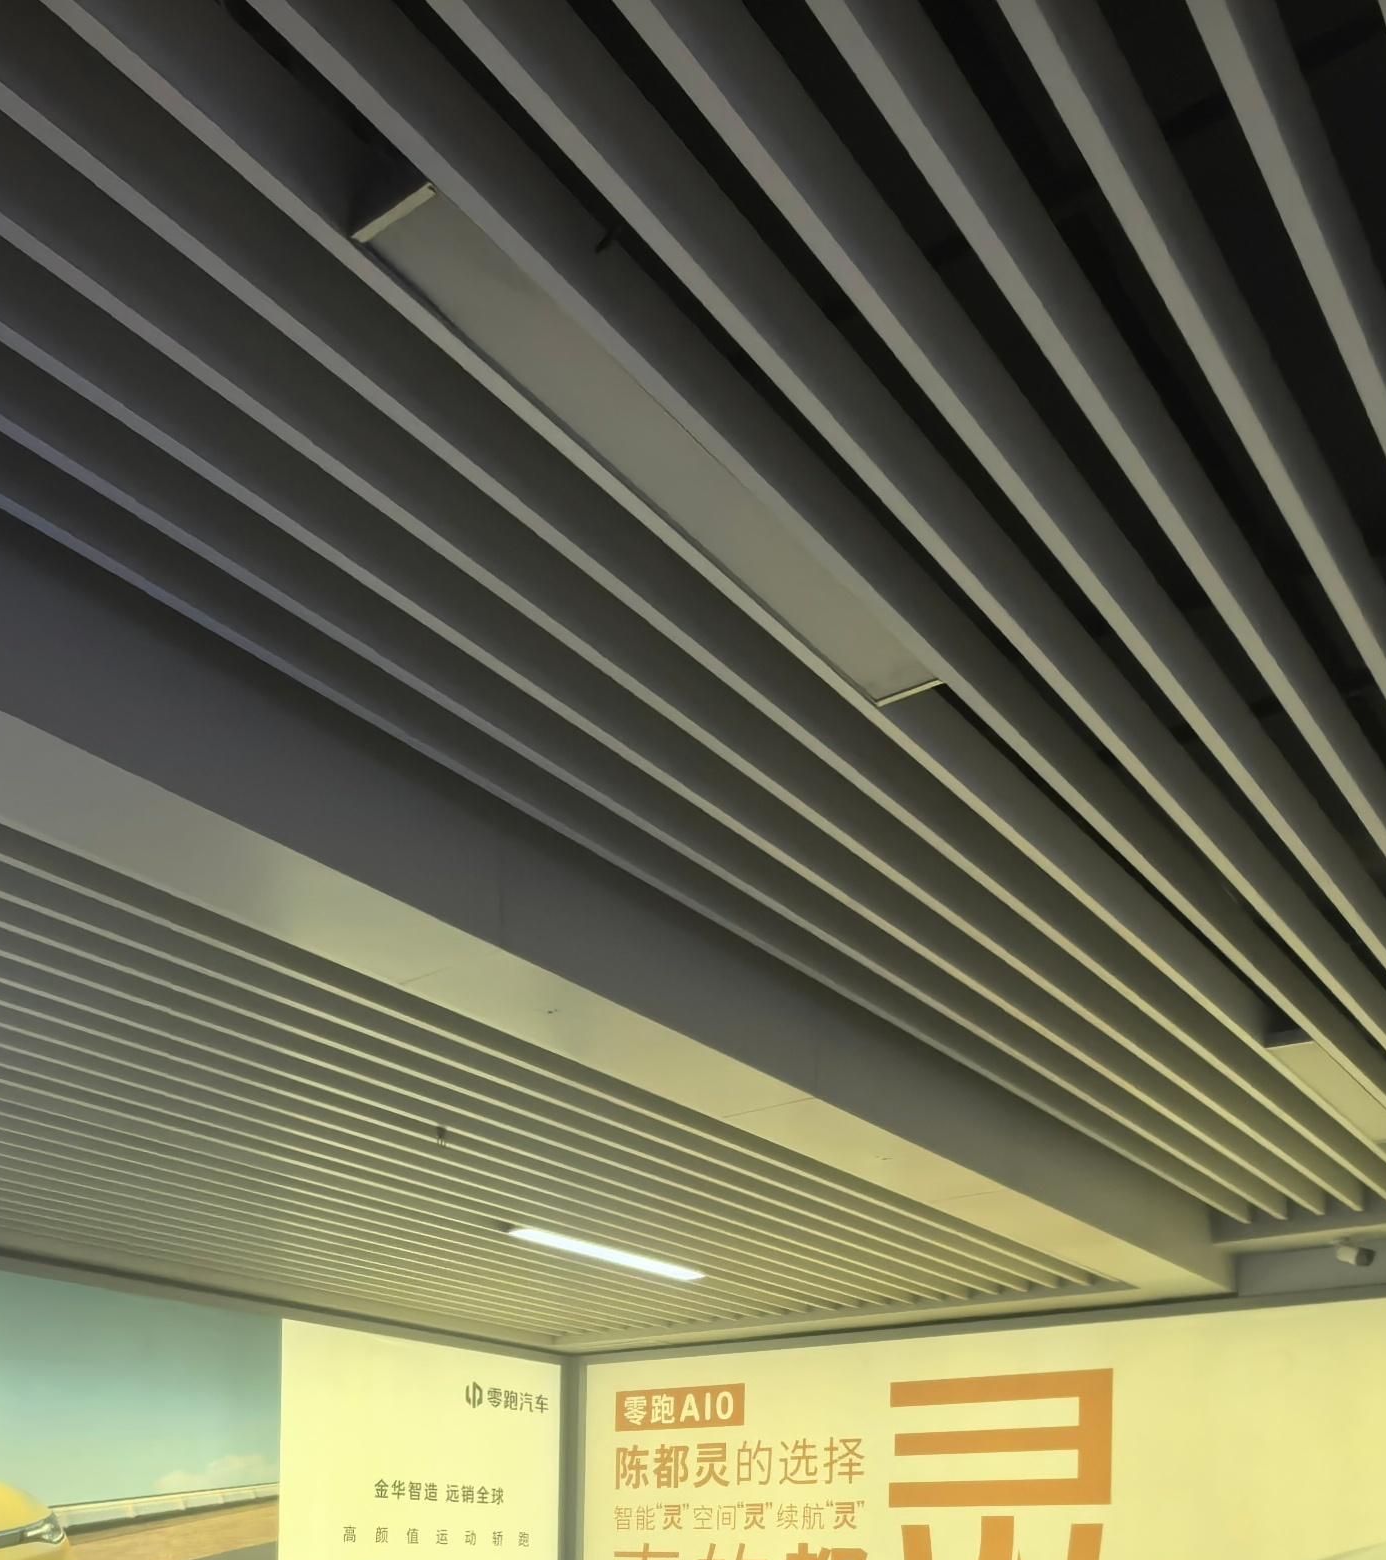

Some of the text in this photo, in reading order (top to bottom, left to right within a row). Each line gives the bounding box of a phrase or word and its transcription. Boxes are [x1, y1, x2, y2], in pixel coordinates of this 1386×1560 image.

[486, 1386, 550, 1414] 零跑汽车
[623, 1390, 734, 1426] 零跑A10
[614, 1436, 865, 1490] 陈都灵的选择
[374, 1478, 505, 1505] 金华智造 远销全球
[342, 1524, 531, 1548] 高颜值运动轿跑
